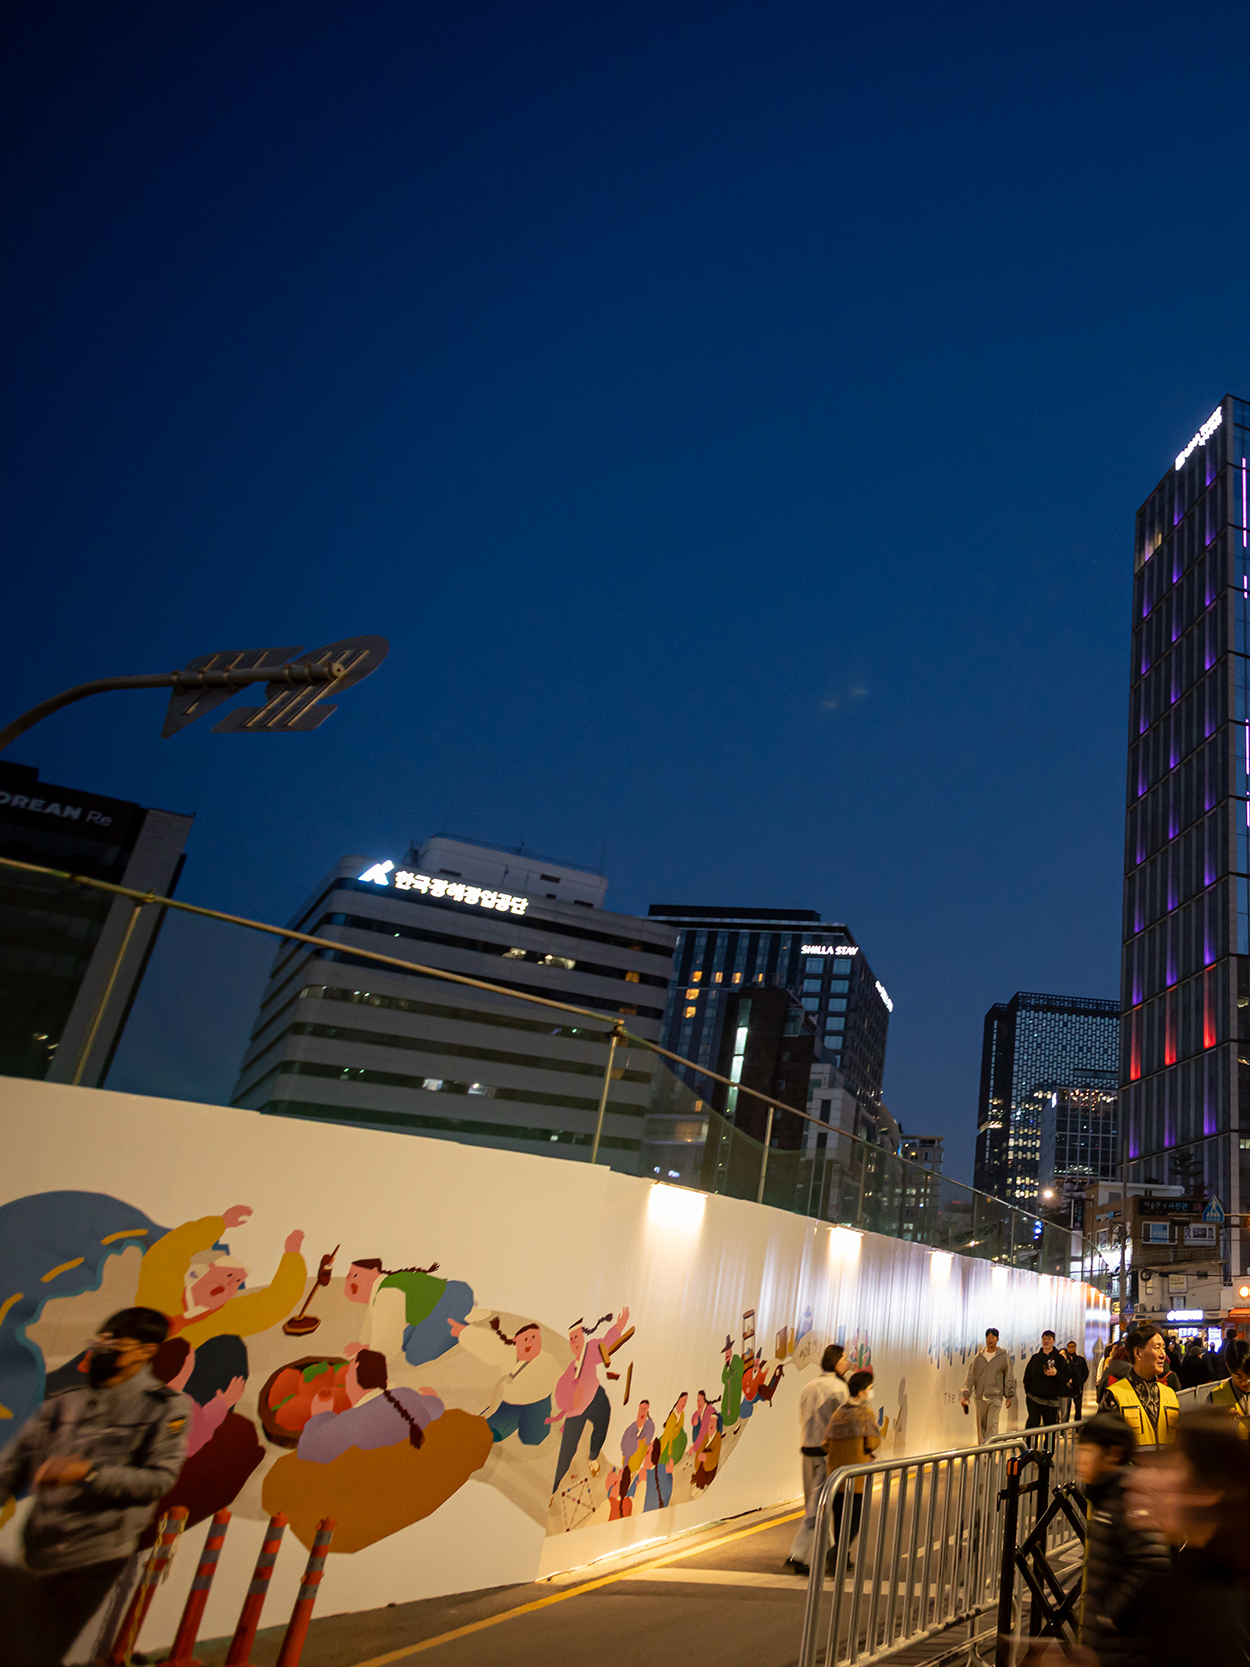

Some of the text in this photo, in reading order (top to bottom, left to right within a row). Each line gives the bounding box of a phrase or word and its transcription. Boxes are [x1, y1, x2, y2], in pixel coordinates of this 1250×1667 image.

[85, 809, 113, 827] Re
[395, 870, 528, 915] 한국광해광업공단
[800, 944, 860, 956] SHILLA STAY
